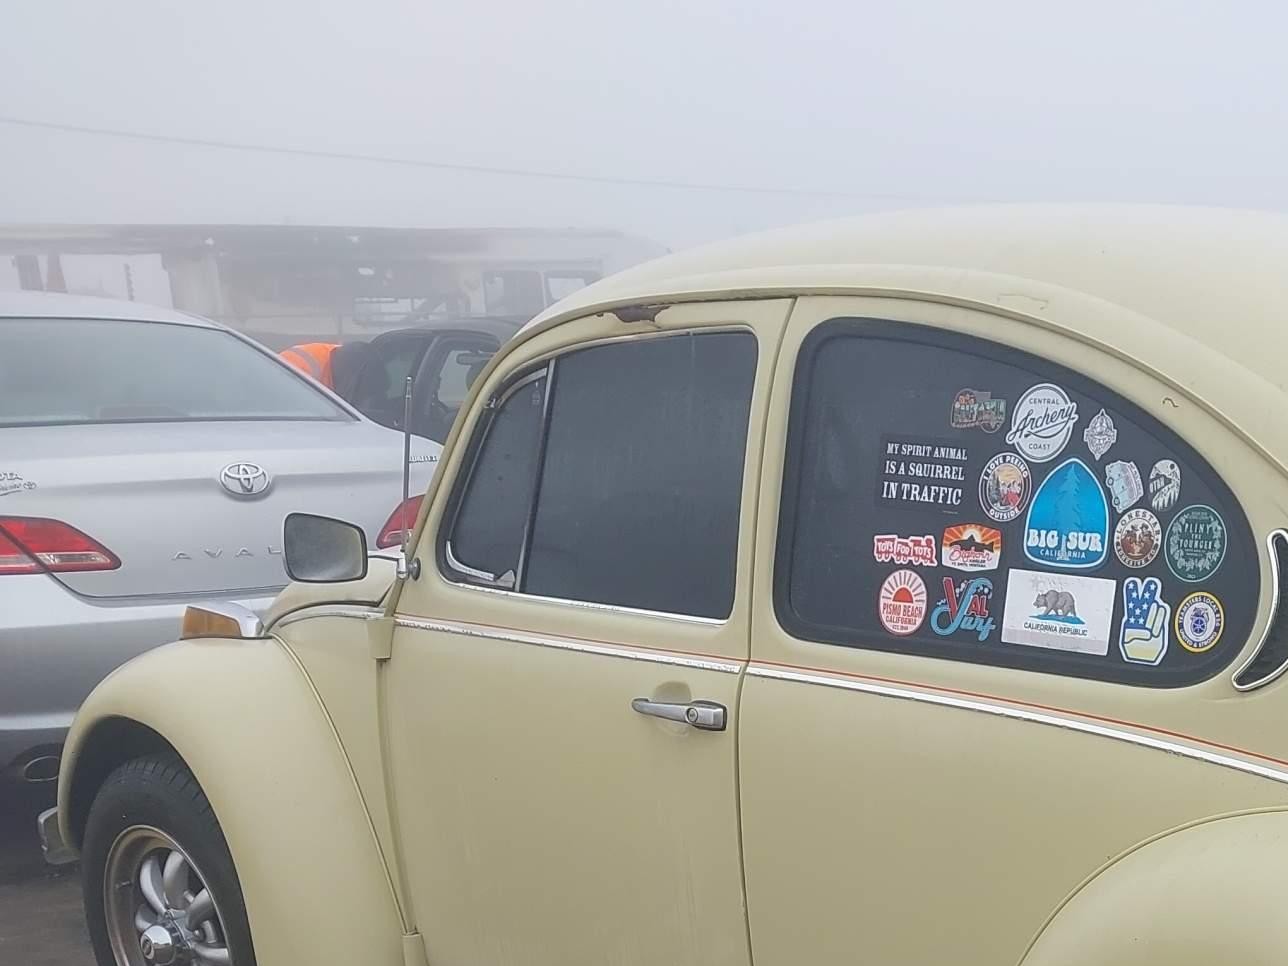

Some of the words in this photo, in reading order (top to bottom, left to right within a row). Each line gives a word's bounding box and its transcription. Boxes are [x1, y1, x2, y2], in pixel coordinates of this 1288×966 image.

[1029, 397, 1060, 405] CENTRAL
[1007, 403, 1076, 441] Archery
[886, 443, 900, 454] MY
[901, 444, 932, 457] SPIRIT
[933, 446, 968, 460] ANIMAL
[884, 460, 897, 474] IS
[898, 462, 905, 475] A
[908, 462, 965, 481] SQUIRREL
[986, 456, 1004, 474] LOVE
[882, 481, 899, 499] IN
[901, 483, 962, 505] TRAFFIC
[989, 506, 1020, 519] OUTSIDE
[1116, 510, 1161, 536] LONESTAR
[877, 540, 894, 553] TOYS
[896, 543, 910, 555] FOR
[913, 546, 932, 558] TOTS
[1027, 528, 1059, 548] BIG
[1066, 531, 1103, 552] SUR
[882, 603, 902, 616] PISMO
[902, 605, 923, 618] BEACH
[1203, 596, 1219, 612] LOCAL
[1023, 622, 1058, 633] CALIFORNIA
[1058, 626, 1088, 636] REPUBLIC
